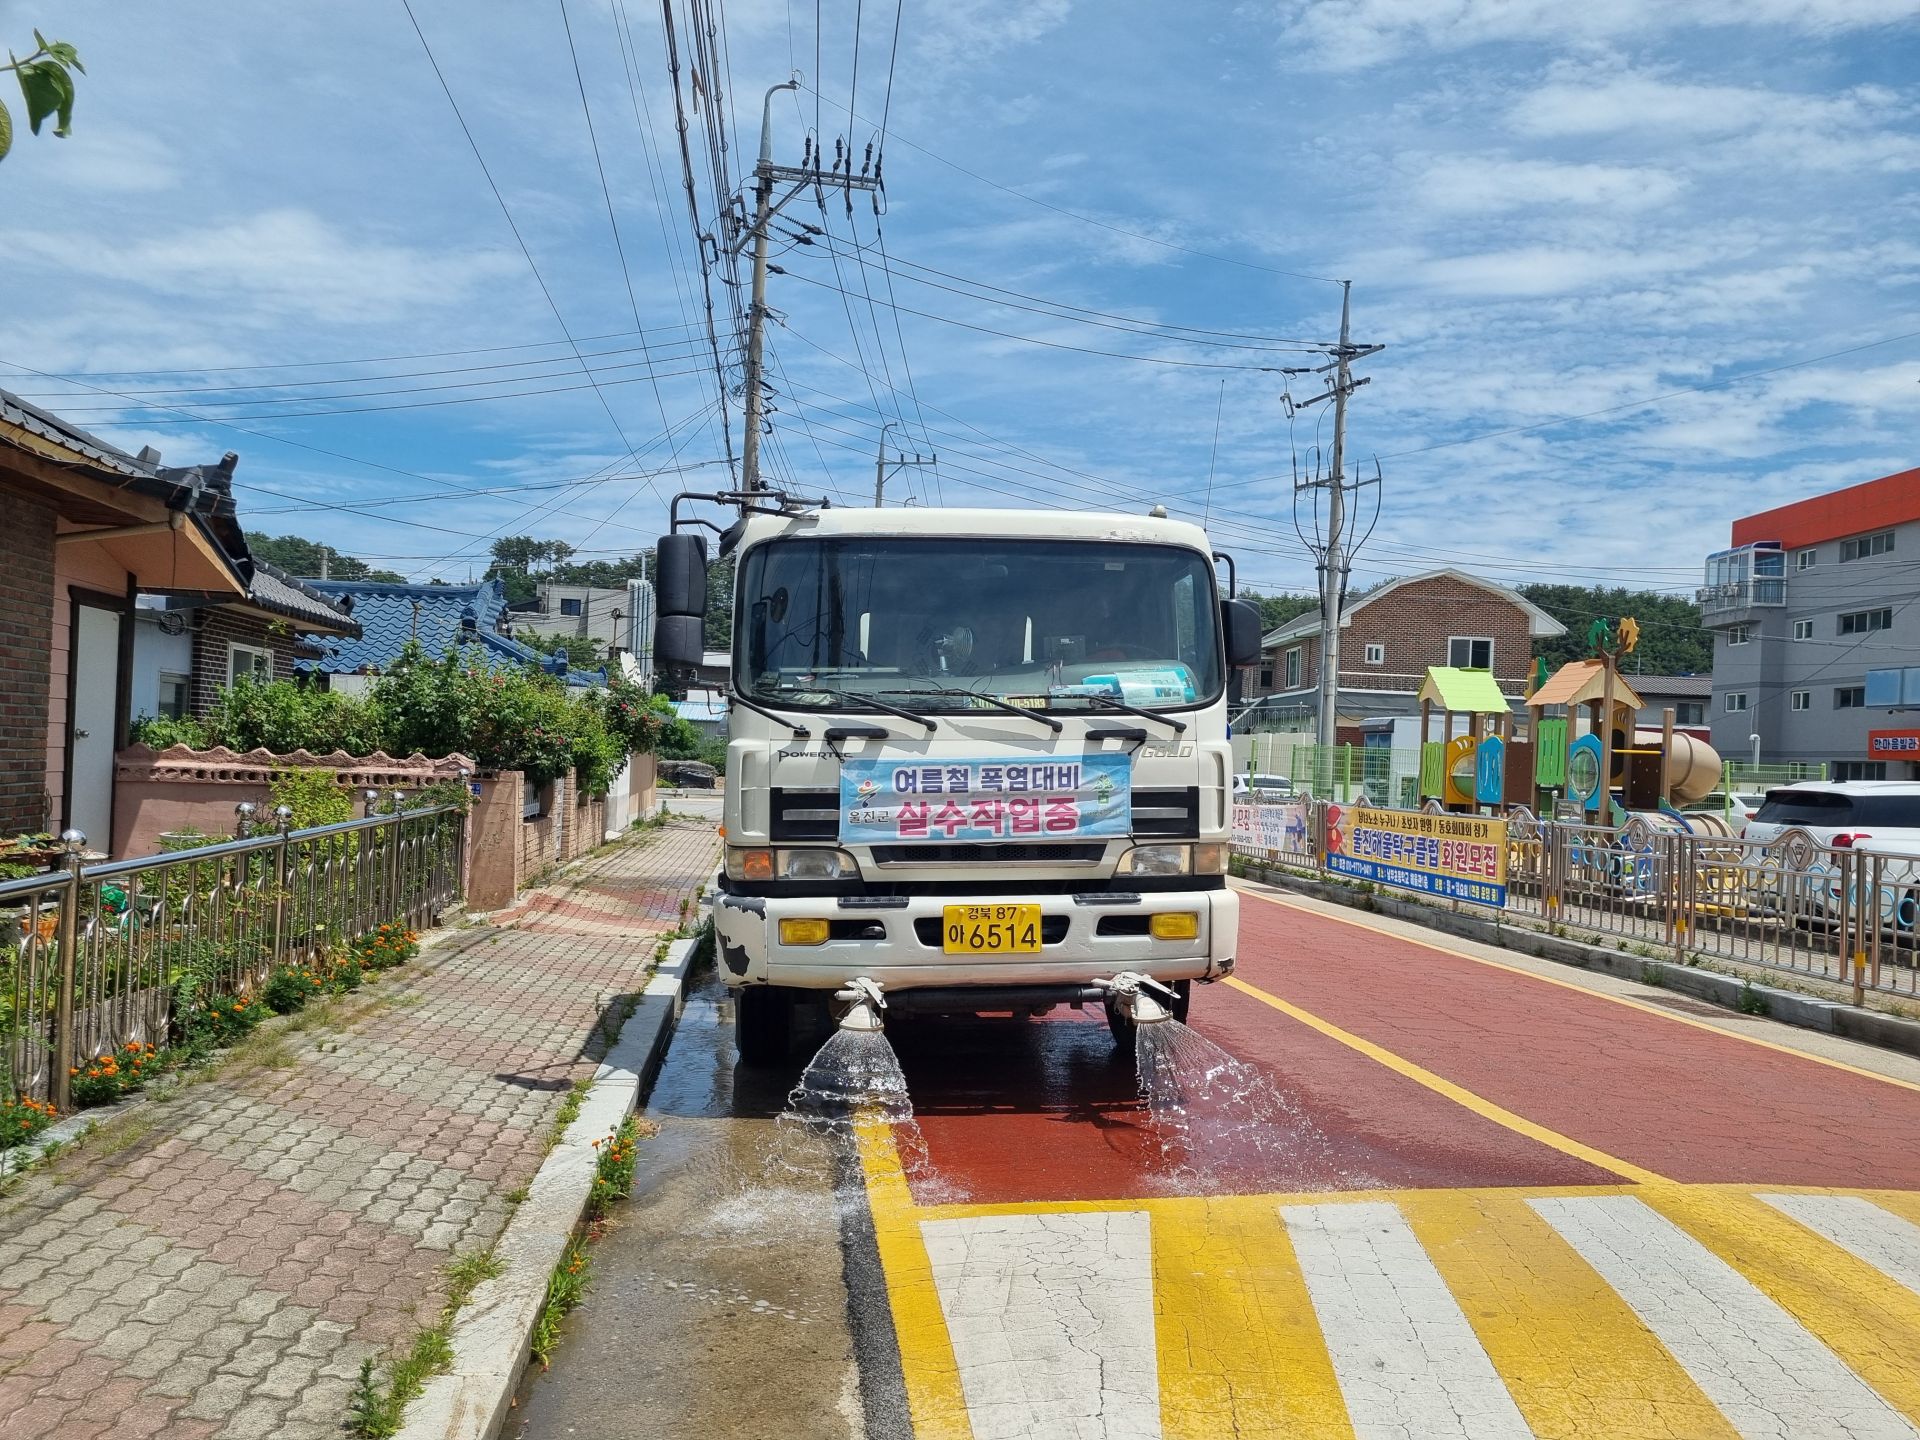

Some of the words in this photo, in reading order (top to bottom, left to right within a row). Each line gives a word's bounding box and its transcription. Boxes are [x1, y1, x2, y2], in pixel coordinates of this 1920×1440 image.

[894, 766, 970, 795] 여름철
[980, 764, 1081, 792] 폭염대비
[848, 809, 889, 825] 울진군
[895, 797, 1079, 836] 살수작업중
[1401, 815, 1419, 831] 초보자
[1420, 817, 1432, 833] 환영
[1353, 827, 1440, 868] 울진해울탁구클럽
[1441, 840, 1497, 877] 회원모집
[967, 907, 991, 920] 경북
[996, 906, 1017, 920] 87
